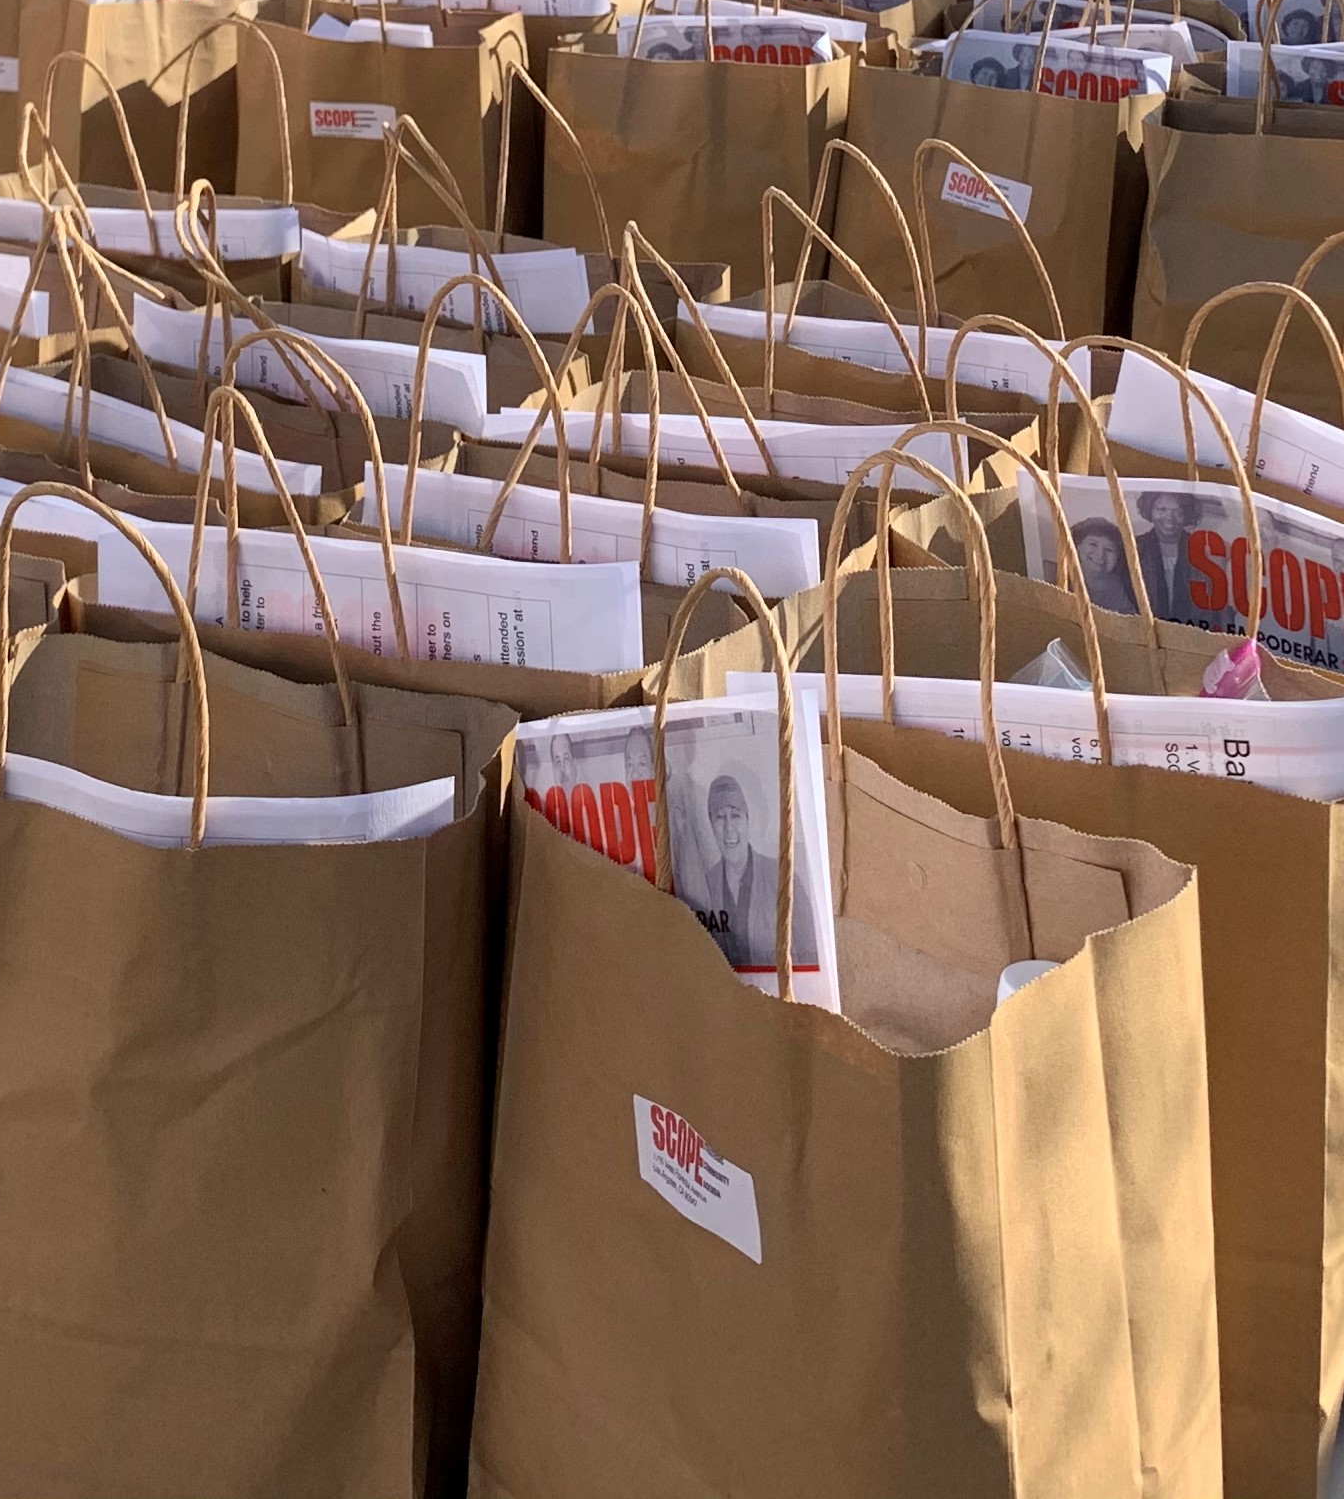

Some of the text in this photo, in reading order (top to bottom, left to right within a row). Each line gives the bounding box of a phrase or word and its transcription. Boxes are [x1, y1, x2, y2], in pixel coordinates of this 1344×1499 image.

[314, 109, 358, 128] SCOPE
[241, 579, 253, 623] to help
[257, 596, 265, 608] to
[374, 611, 382, 629] the
[443, 611, 451, 627] on
[515, 609, 524, 623] at
[316, 622, 323, 631] a
[429, 624, 436, 636] to
[650, 1104, 705, 1187] SCOPE
